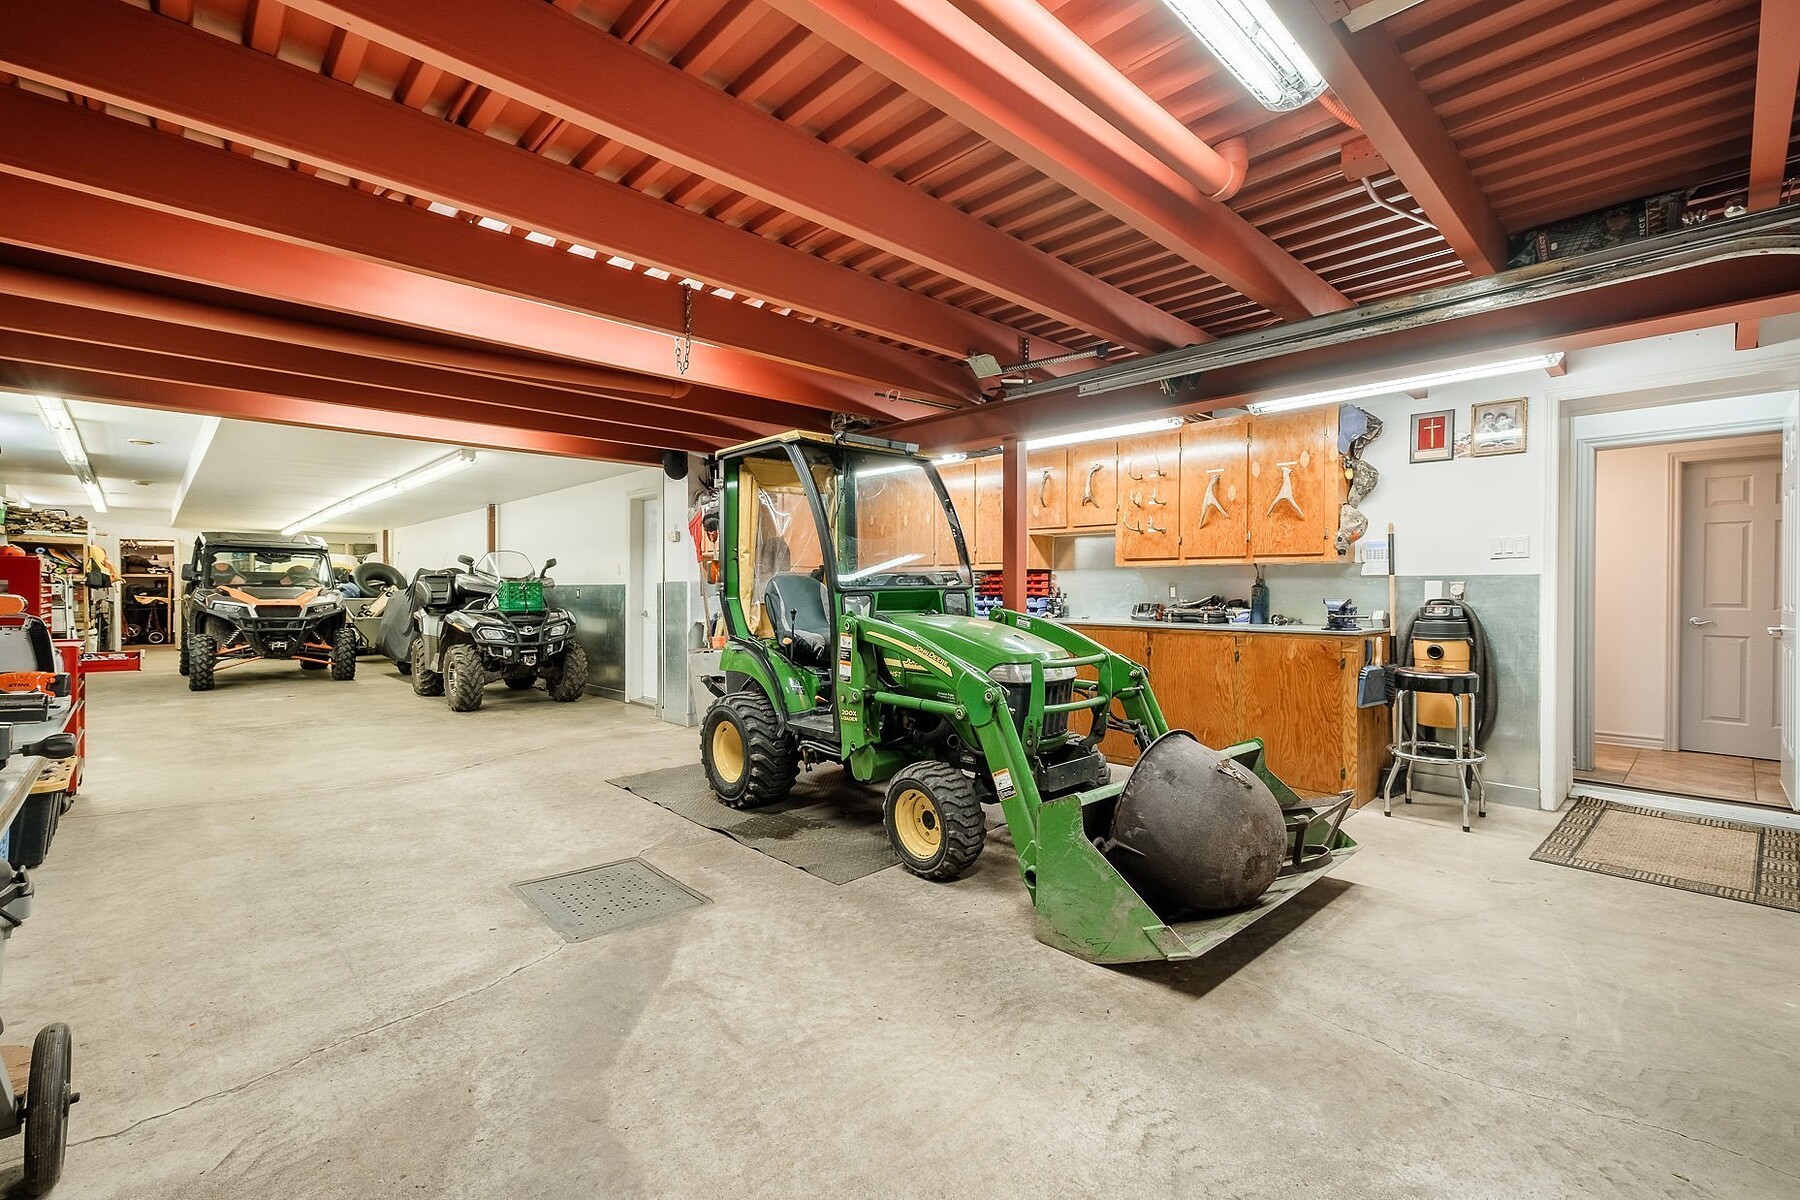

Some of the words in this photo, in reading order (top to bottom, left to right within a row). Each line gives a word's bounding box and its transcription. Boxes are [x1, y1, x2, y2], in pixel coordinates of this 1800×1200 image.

[913, 644, 929, 657] JOHN
[928, 651, 949, 668] DEERE
[841, 709, 857, 717] 200X
